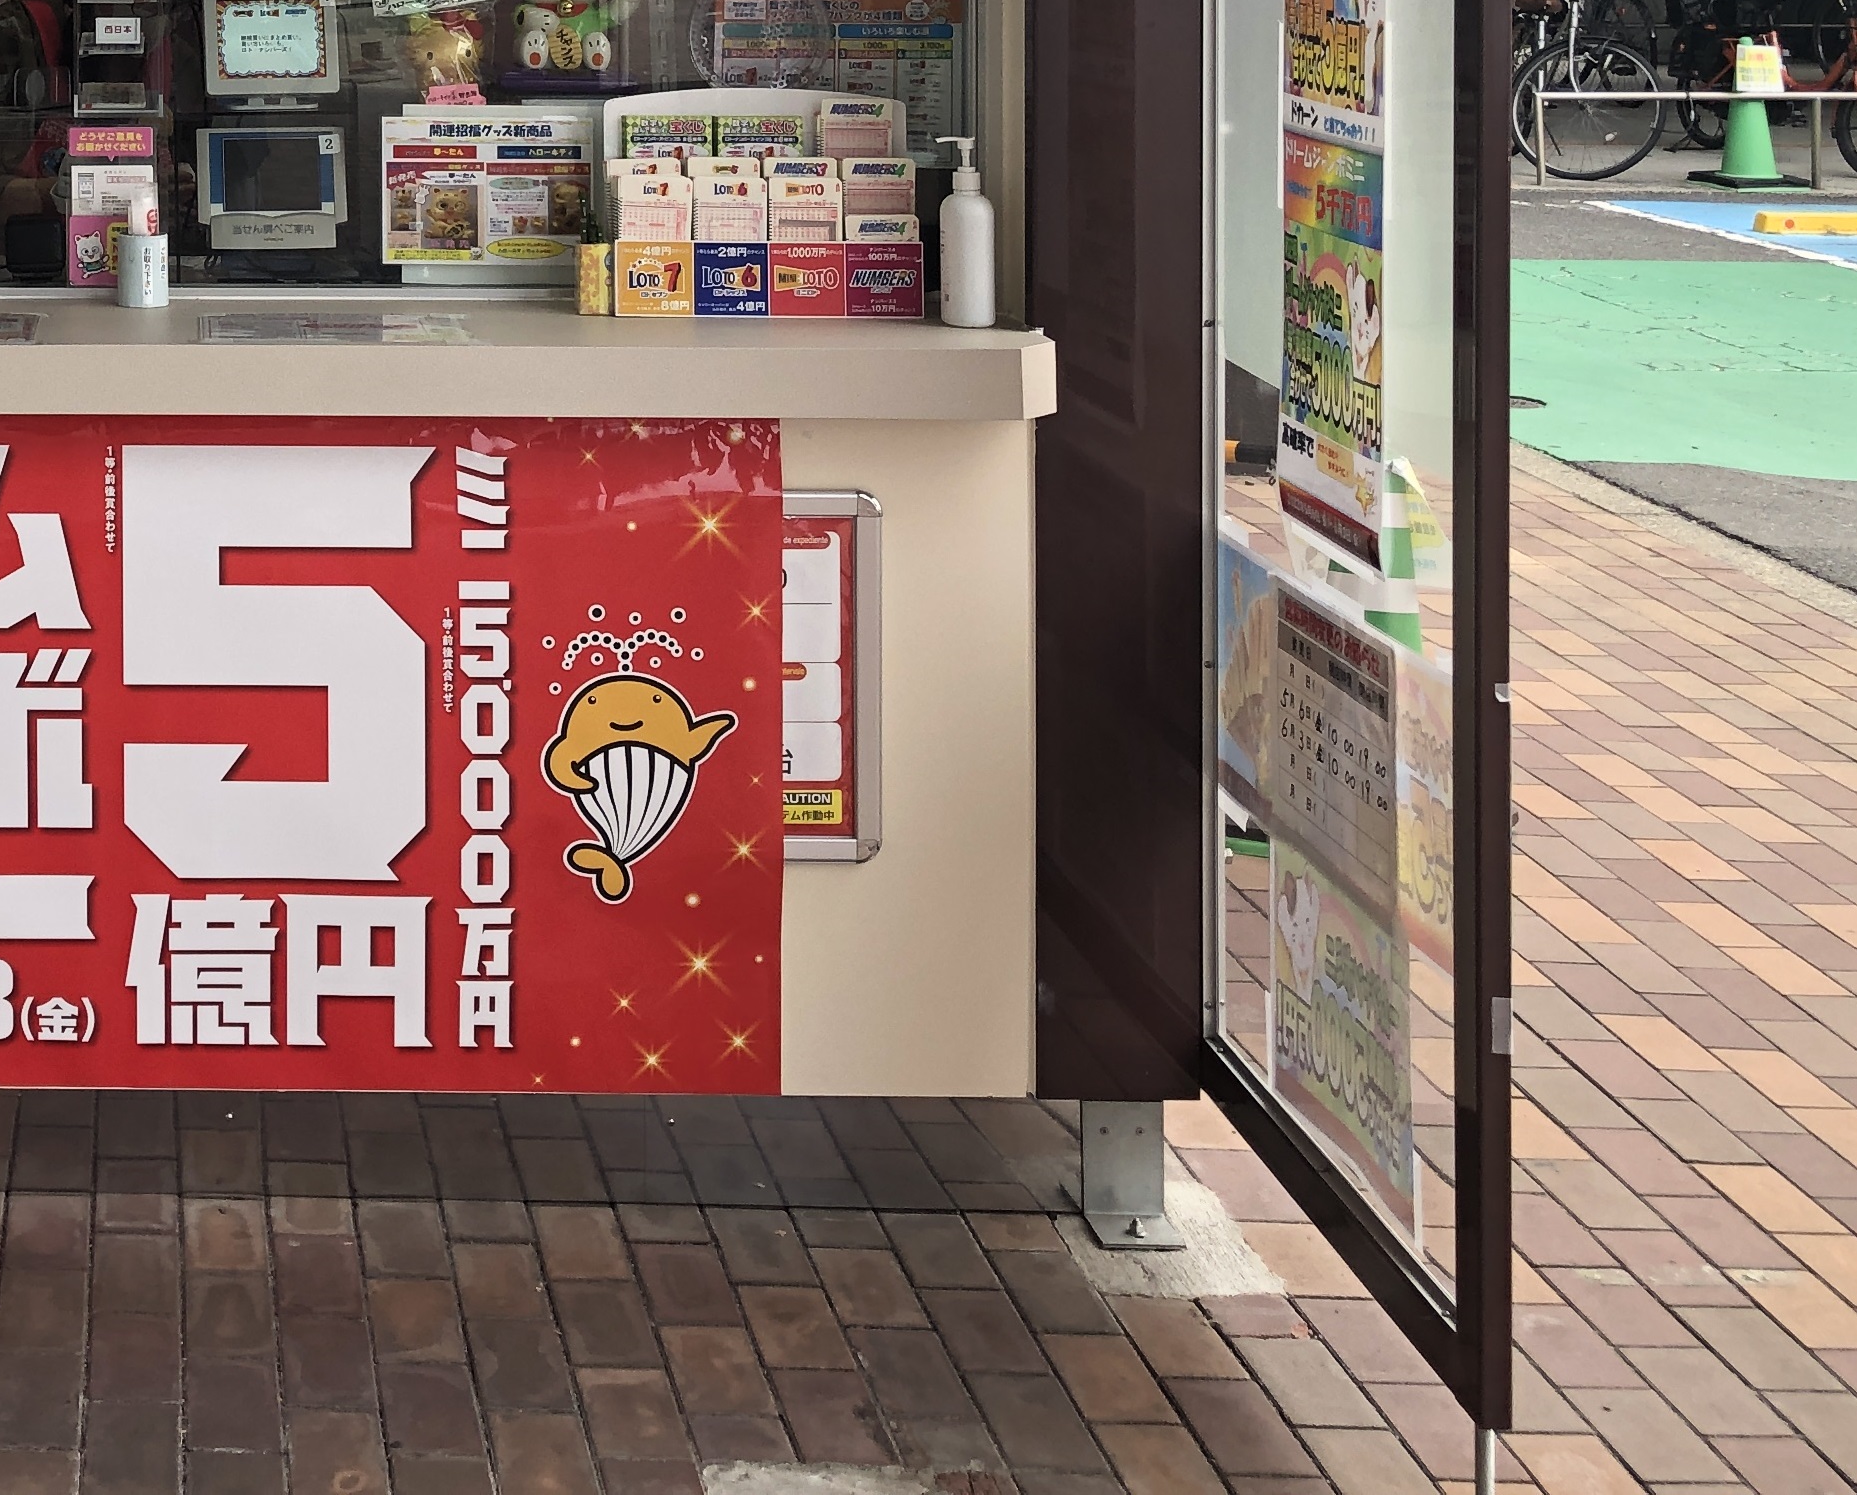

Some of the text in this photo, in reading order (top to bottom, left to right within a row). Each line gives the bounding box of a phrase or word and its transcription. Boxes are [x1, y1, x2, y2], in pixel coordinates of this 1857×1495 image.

[556, 30, 576, 67] チャンス
[1291, 100, 1319, 127] ドカーン
[669, 120, 797, 134] 宝くじ 宝くじ
[325, 139, 333, 149] 2
[802, 184, 824, 195] LOTO
[1316, 184, 1373, 237] 5千万円
[642, 246, 672, 256] 4億円
[717, 246, 747, 257] 2億円
[868, 253, 897, 261] 100万円
[629, 262, 681, 292] LOTO7
[702, 263, 758, 291] LOTO6
[802, 269, 840, 289] LOTO
[850, 269, 917, 288] NUMBERS
[736, 302, 766, 312] 4億円
[871, 304, 896, 313] 10万円
[105, 446, 116, 553] 1等・前後賞合わせて
[122, 445, 437, 882] 5
[442, 606, 454, 712] 1等・前後賞合わせて
[783, 793, 831, 804] AUTION
